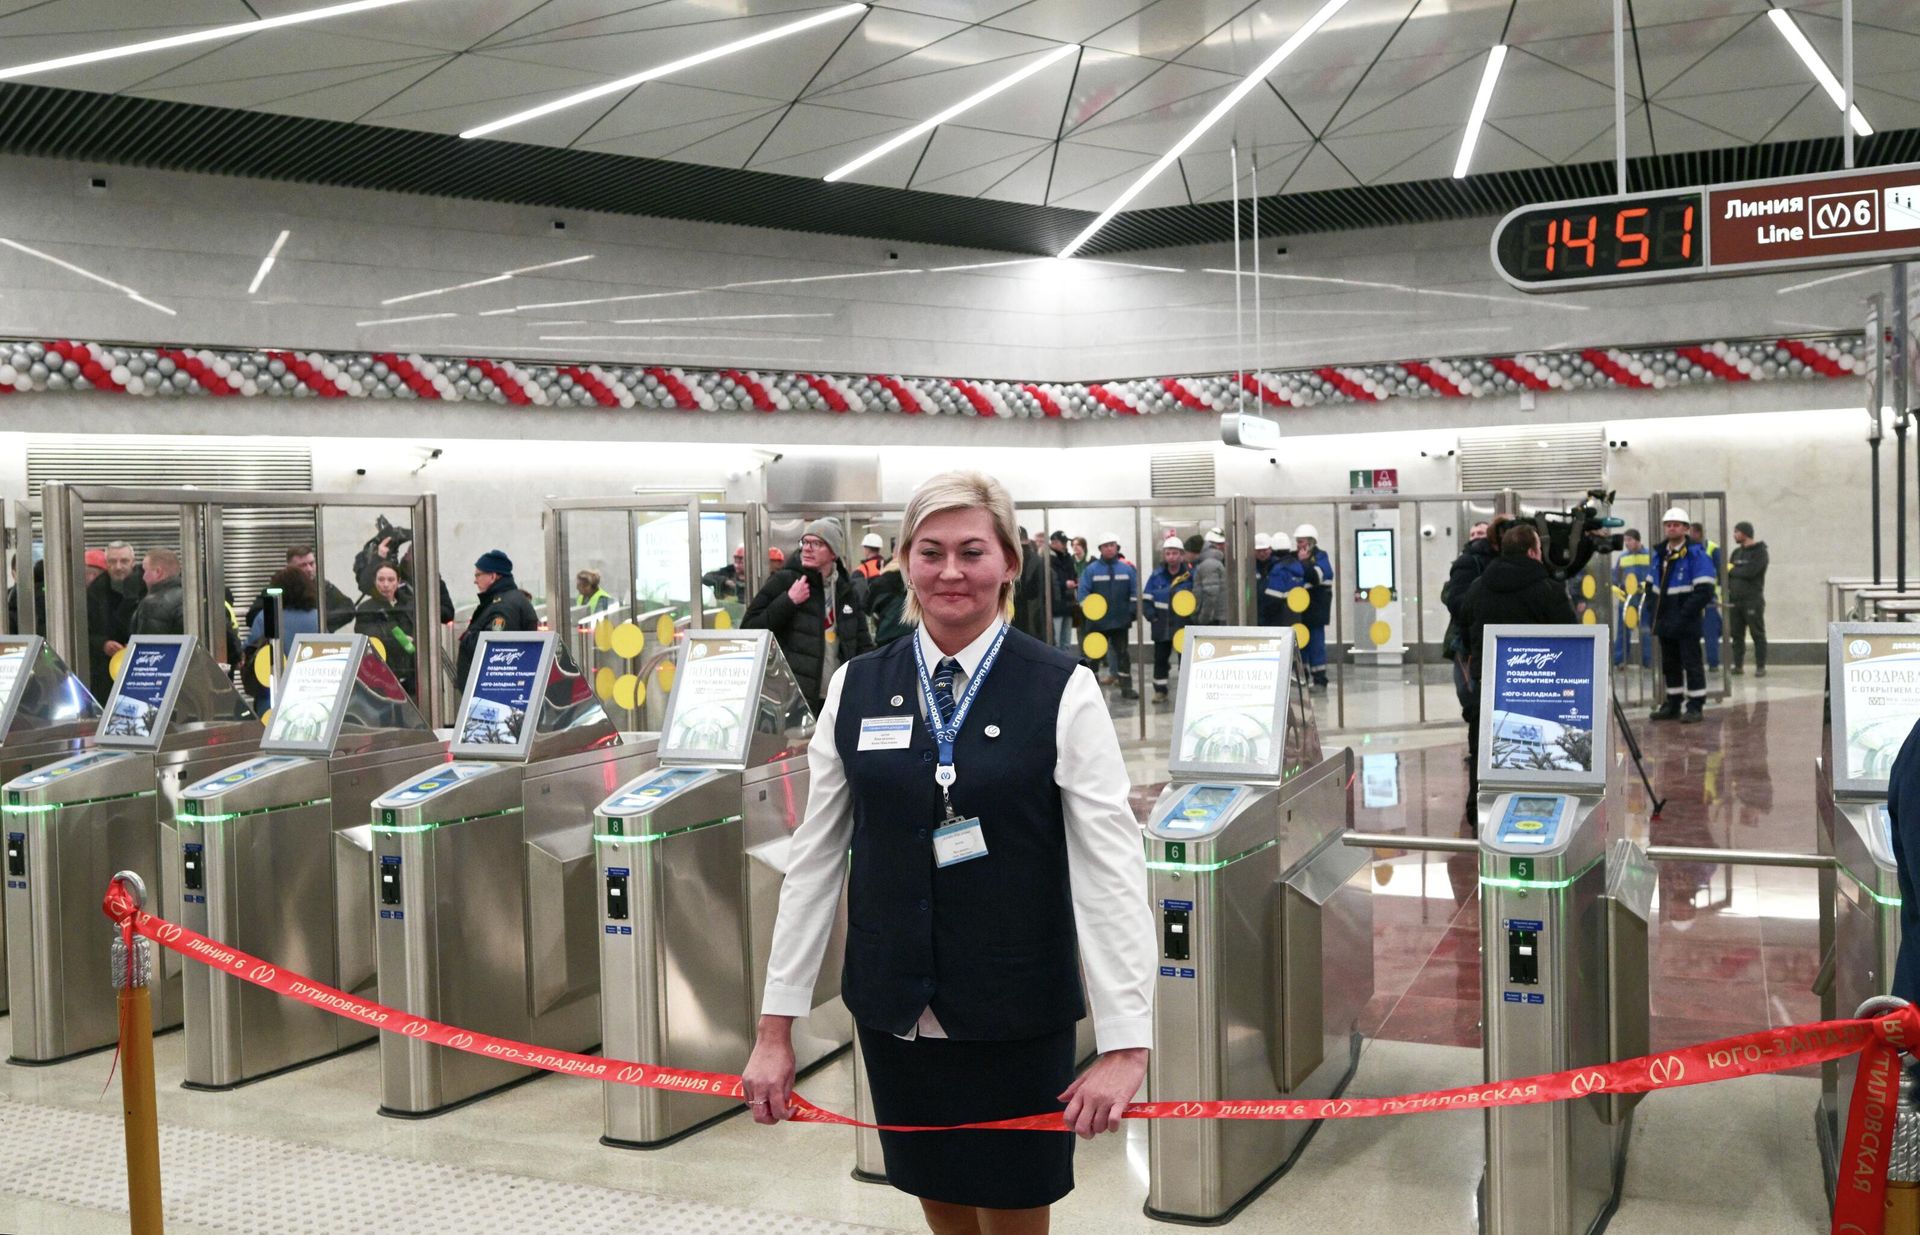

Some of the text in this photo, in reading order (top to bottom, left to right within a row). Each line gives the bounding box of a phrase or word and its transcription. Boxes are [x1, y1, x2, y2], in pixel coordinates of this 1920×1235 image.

[1724, 196, 1804, 220] Линия
[1757, 223, 1804, 245] Line
[1853, 199, 1872, 226] 6
[926, 691, 943, 730] ДОХОДОВ
[952, 695, 972, 728] СЛУЖБА
[968, 668, 986, 696] СБОРА
[1172, 845, 1180, 859] 6
[1518, 862, 1527, 877] 5
[186, 938, 234, 965] ЛИНИЯ
[235, 959, 247, 970] 6
[288, 981, 388, 1024] ПУТИЛОВСКАЯ
[483, 1043, 607, 1076] ЮГО-ЗАПАДНАЯ
[652, 1073, 708, 1091] ЛИНИЯ
[711, 1080, 722, 1092] 6
[1218, 1104, 1288, 1116] ЛИНИЯ
[1292, 1104, 1305, 1115] 6
[1382, 1084, 1539, 1111] ПУТИЛОВСКАЯ
[1852, 1050, 1891, 1193] ТИЛОВСКАЯ
